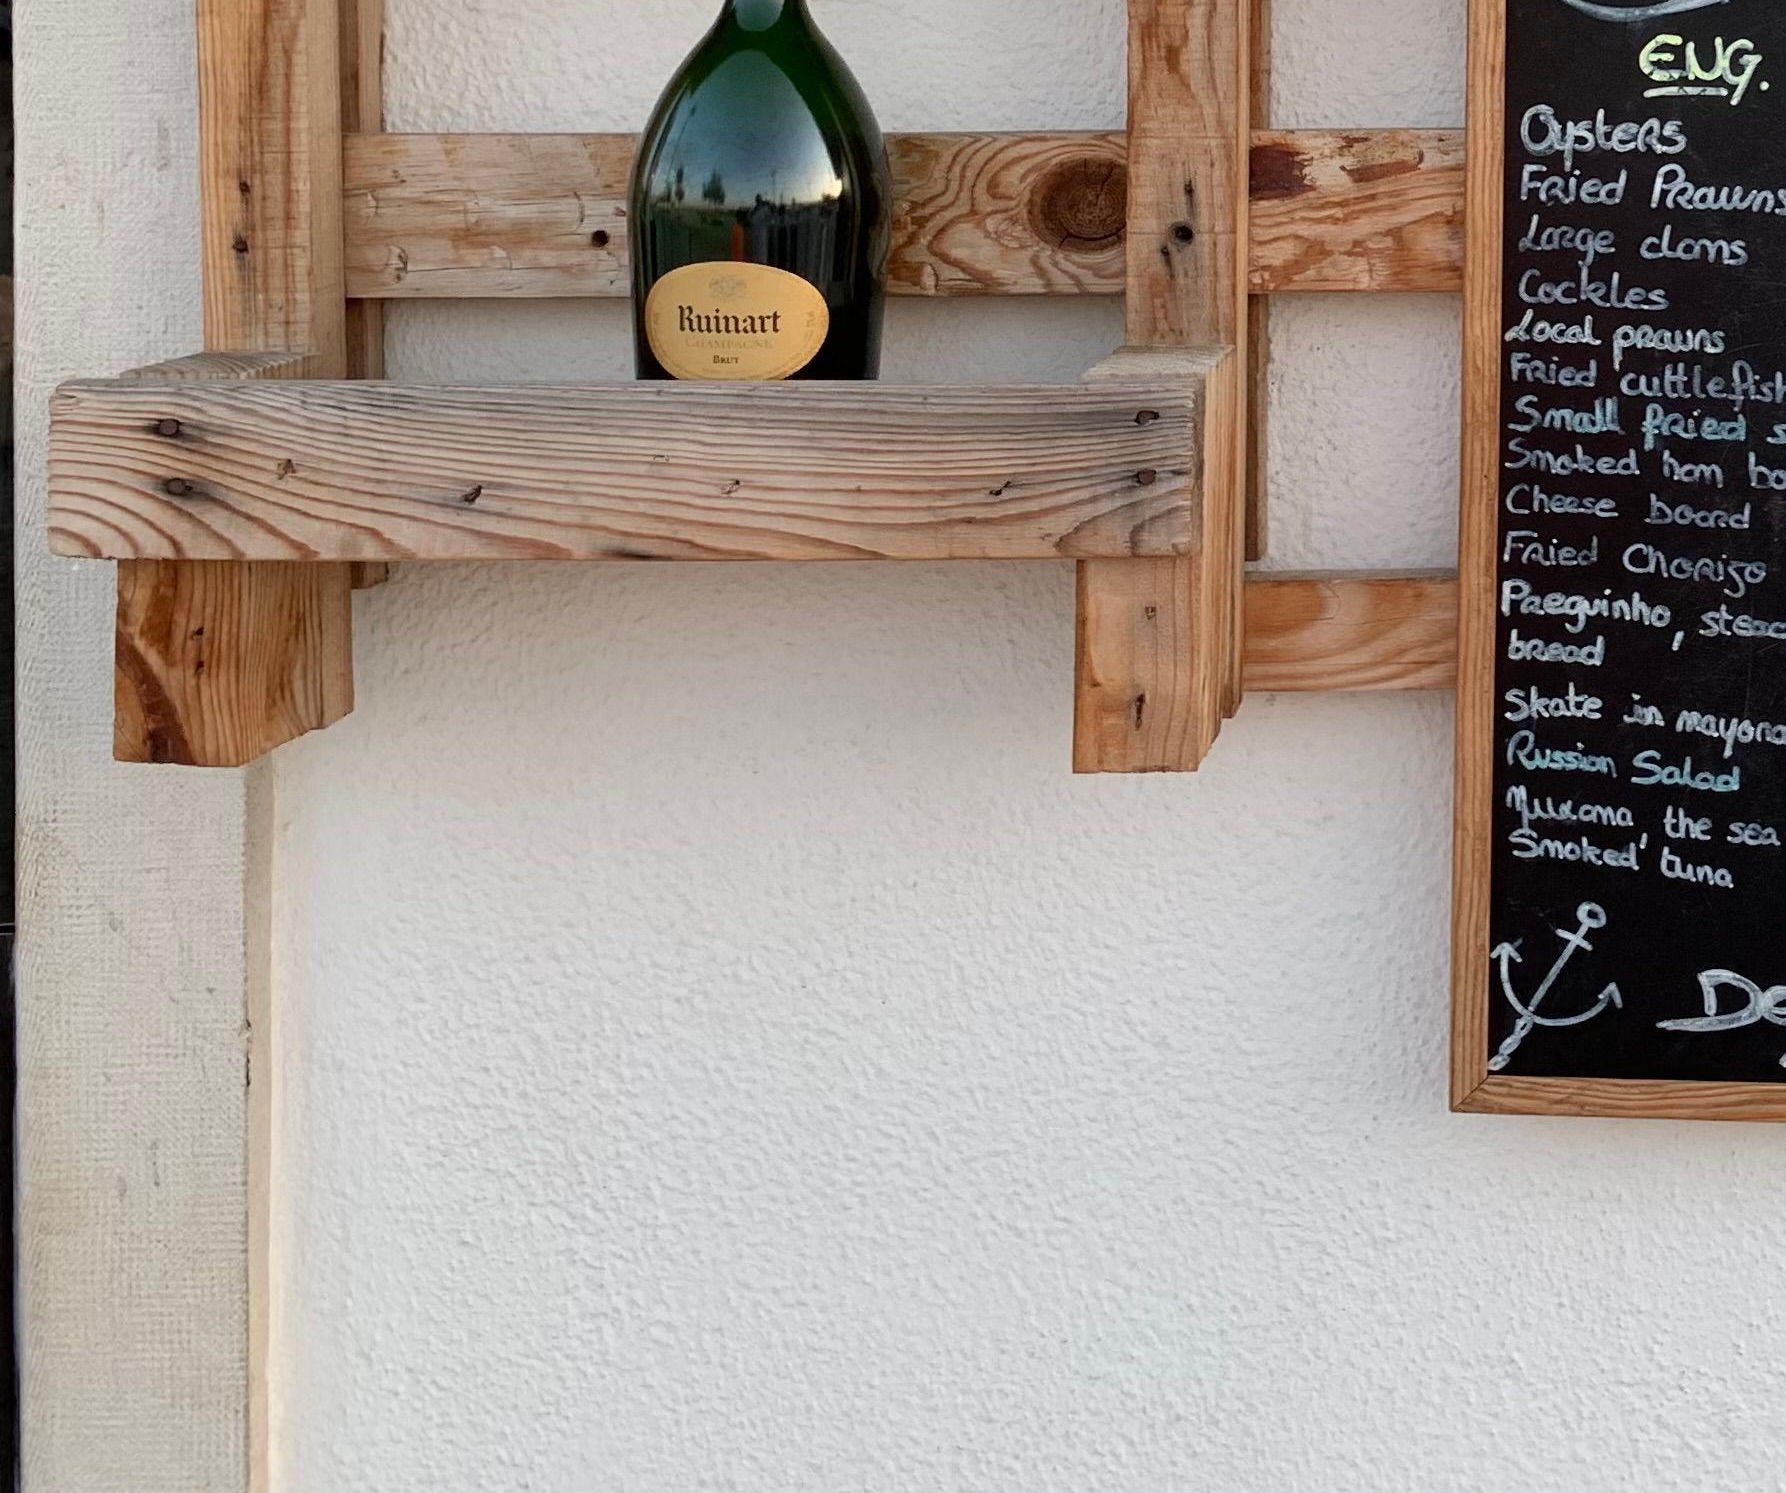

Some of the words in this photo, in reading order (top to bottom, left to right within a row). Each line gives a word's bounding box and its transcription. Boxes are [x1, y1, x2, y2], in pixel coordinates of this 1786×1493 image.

[1640, 224, 1749, 266] clams
[1518, 262, 1670, 311] Cockles
[678, 305, 782, 334] Ruinart
[1504, 309, 1603, 345] Local
[1508, 395, 1626, 436] Small
[1504, 437, 1640, 477] Smoked
[1662, 450, 1725, 489] ham
[1505, 483, 1619, 518] Cheese
[1505, 681, 1603, 722] Skate
[1506, 729, 1618, 779] Russian
[1630, 750, 1741, 793] Salad
[1663, 805, 1714, 842] the
[1727, 819, 1782, 847] sea
[1660, 845, 1736, 890] tuna
